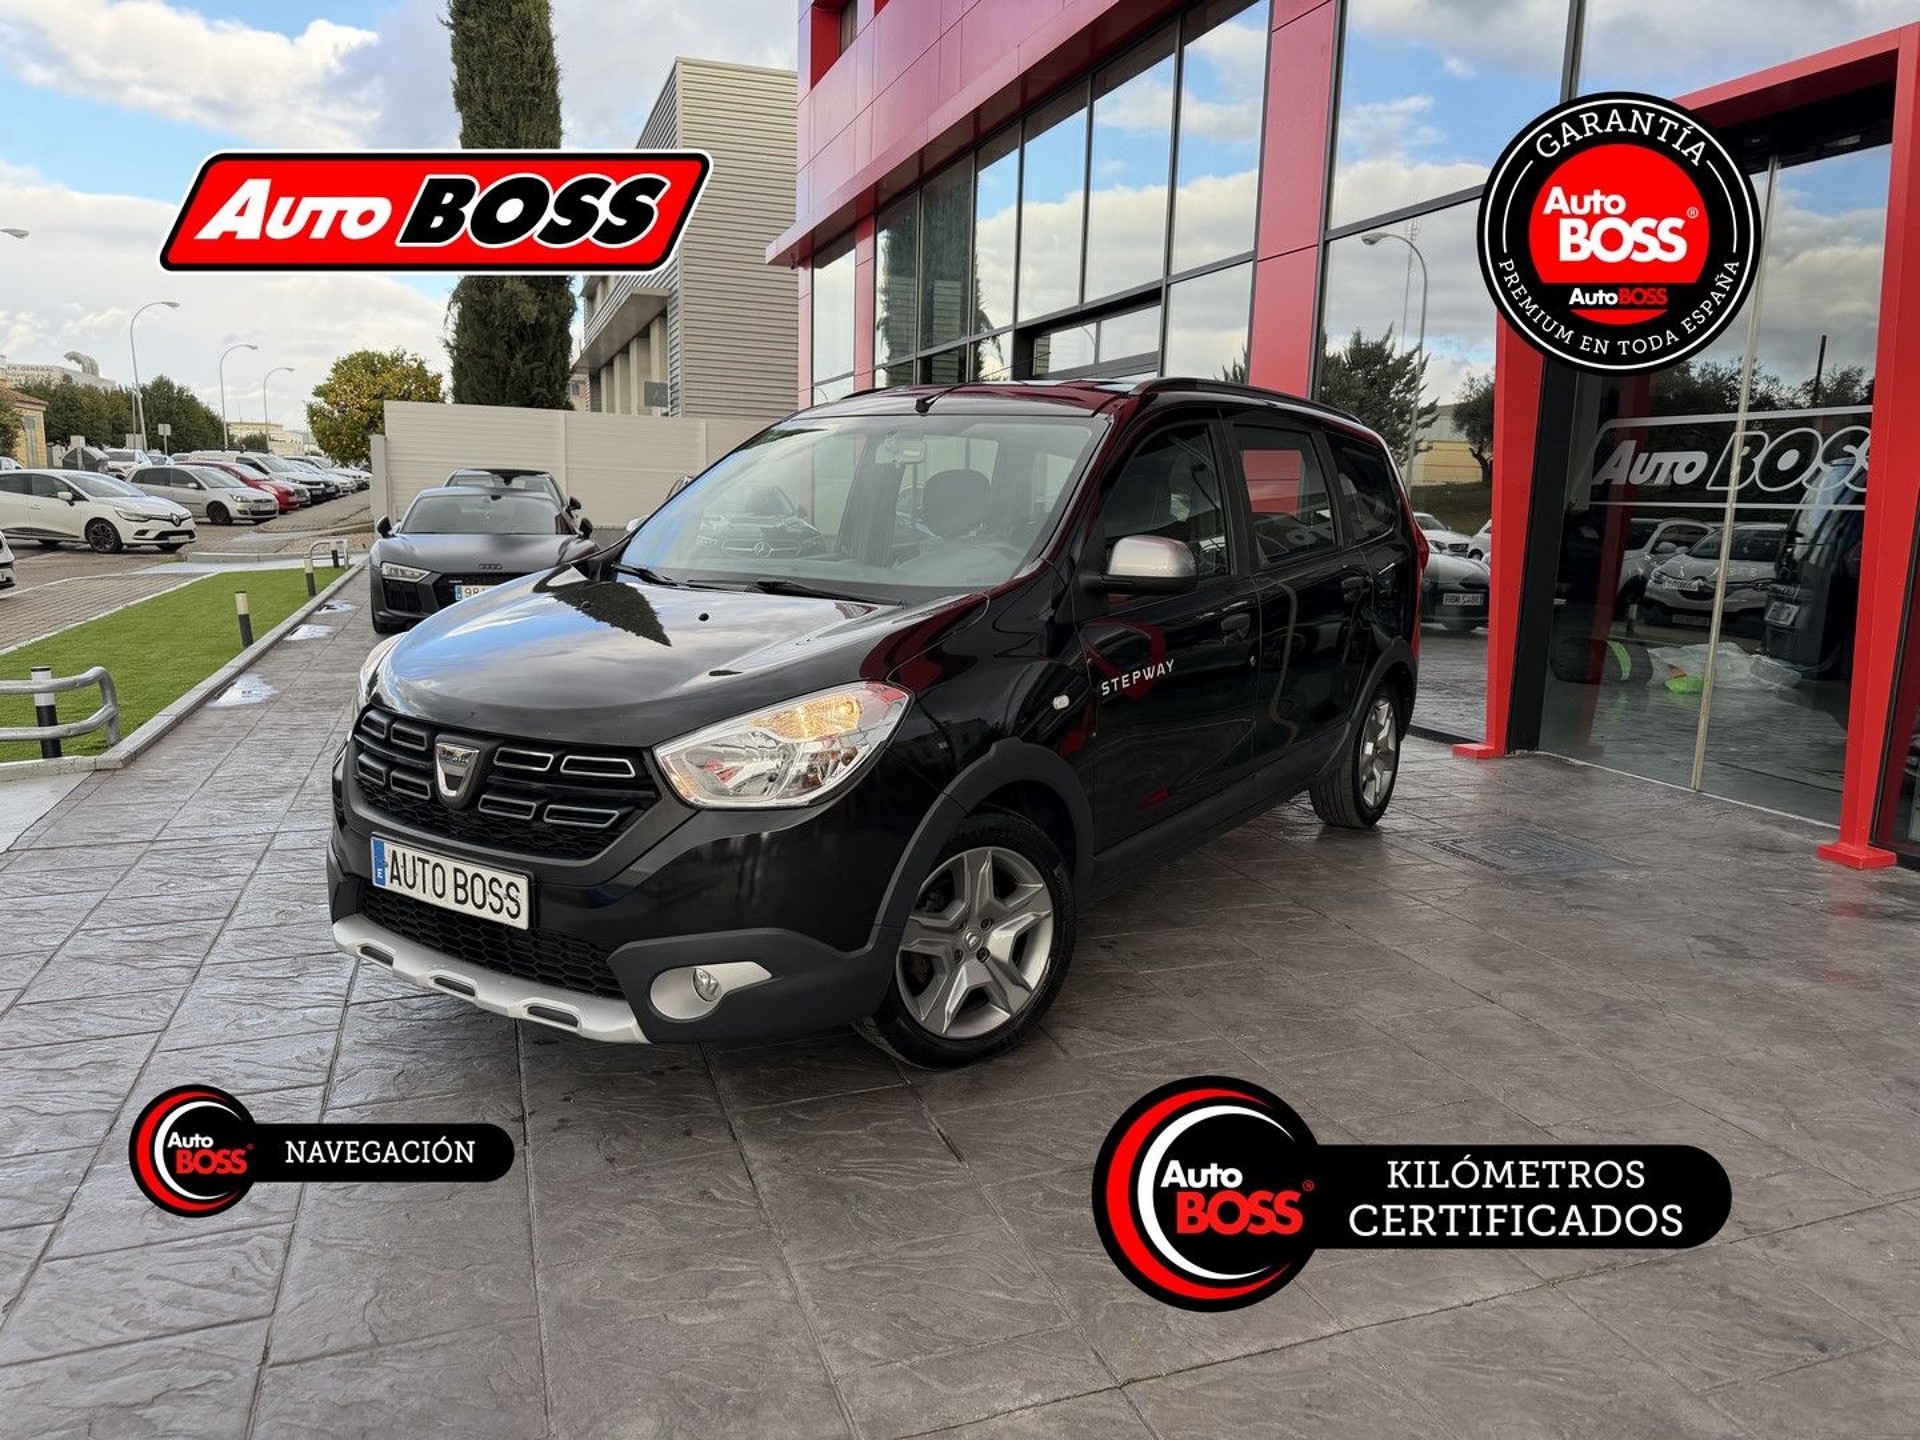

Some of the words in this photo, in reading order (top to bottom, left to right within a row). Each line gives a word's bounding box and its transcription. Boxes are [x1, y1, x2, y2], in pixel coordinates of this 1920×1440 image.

[1101, 658, 1176, 697] STEPWAY
[389, 849, 447, 900] AUTO
[453, 867, 521, 920] BOSS
